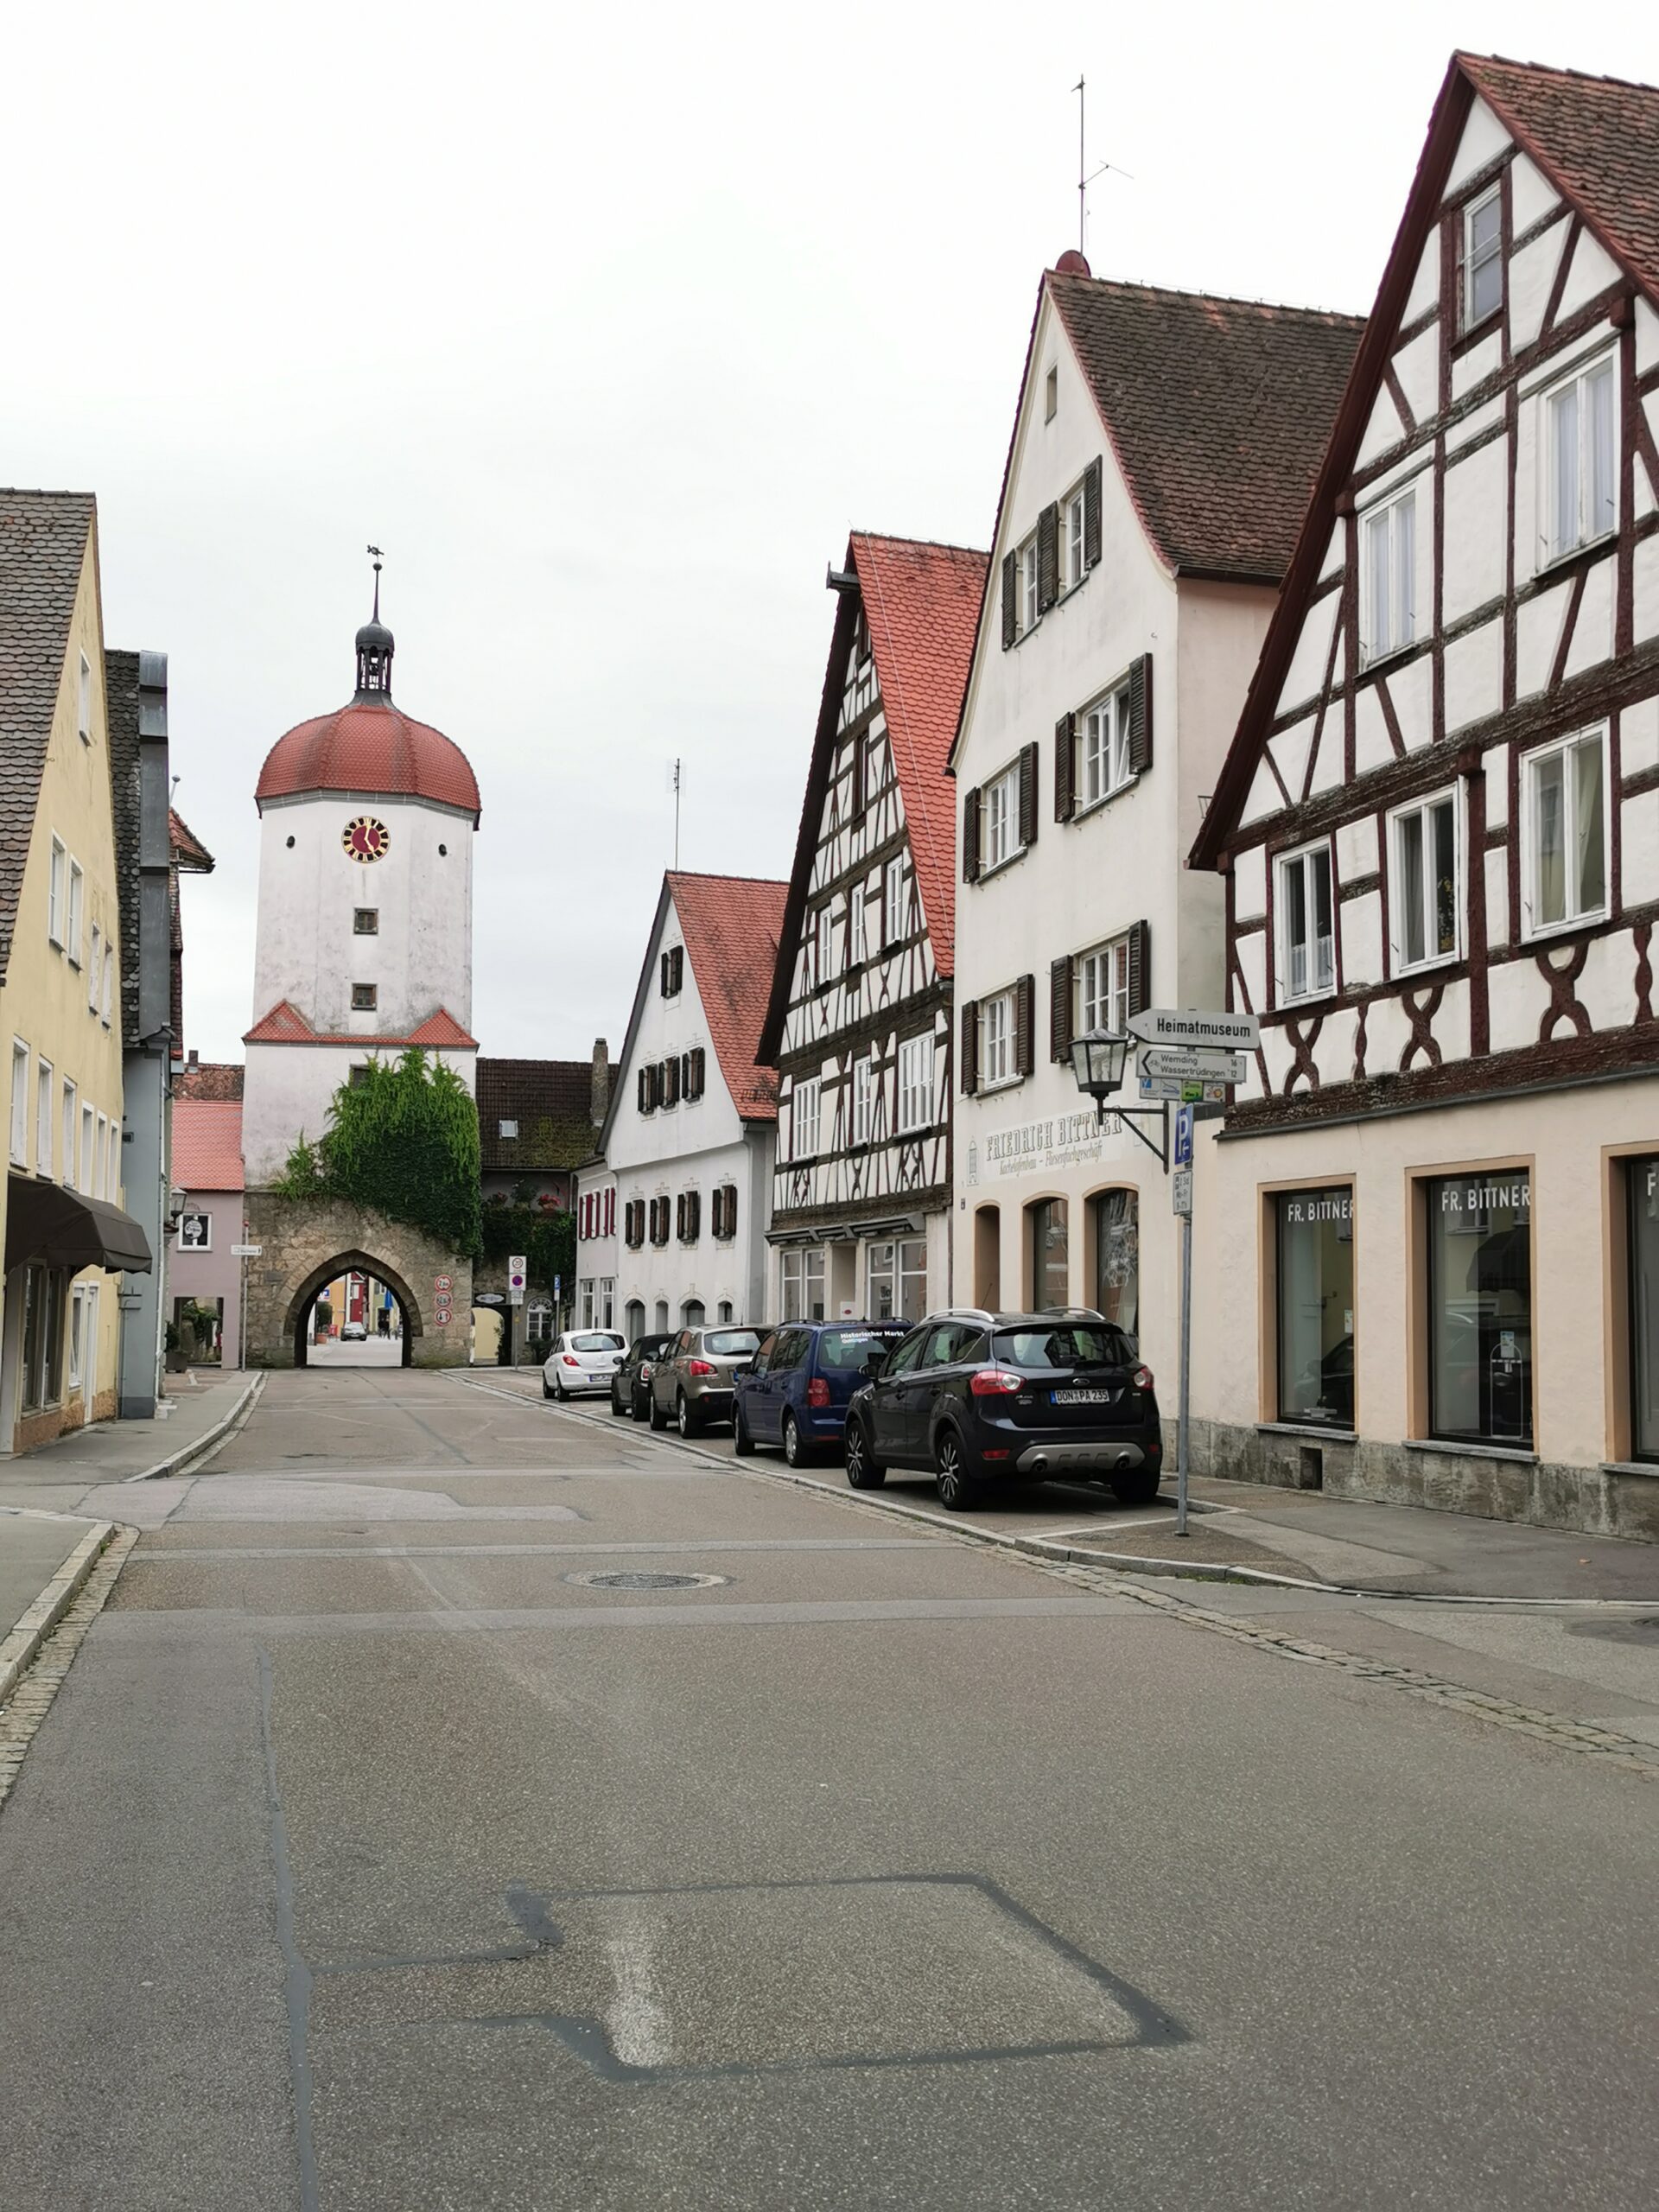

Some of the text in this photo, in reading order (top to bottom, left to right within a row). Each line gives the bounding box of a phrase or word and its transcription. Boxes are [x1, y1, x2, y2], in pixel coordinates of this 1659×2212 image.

[1157, 1018, 1250, 1037] Heimatmuseum
[1160, 1054, 1237, 1067] Wemding 16
[1160, 1065, 1237, 1079] Wassertrüdingen 12
[986, 1109, 1122, 1162] FRIEDRICH BITTNER
[1178, 1114, 1189, 1157] P
[1442, 1184, 1530, 1211] FR. BITTNER
[1287, 1203, 1305, 1223] FR.
[840, 1331, 882, 1339] Historischer
[1057, 1389, 1108, 1402] DON PA 235
